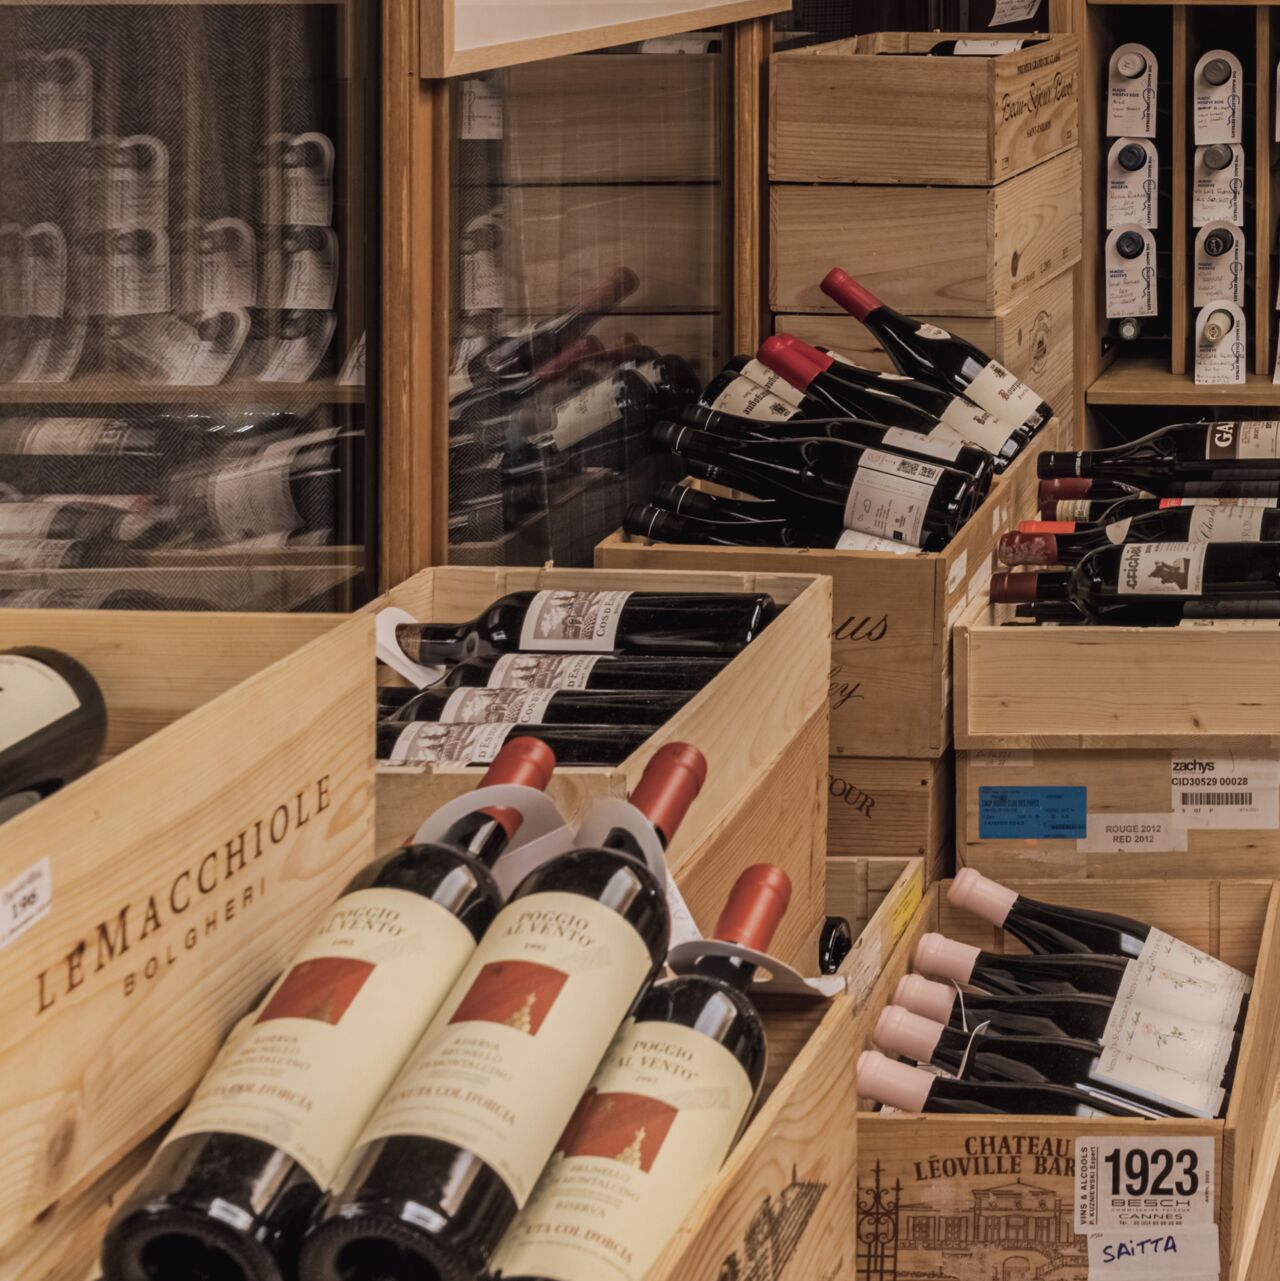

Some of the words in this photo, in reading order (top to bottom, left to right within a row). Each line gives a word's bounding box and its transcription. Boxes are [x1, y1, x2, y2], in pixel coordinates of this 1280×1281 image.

[1172, 759, 1216, 774] zachys
[1219, 776, 1248, 786] 00028
[1106, 825, 1139, 834] ROUGE
[1141, 824, 1162, 833] 2012
[1112, 834, 1132, 844] RED
[1134, 834, 1155, 843] 2012
[518, 910, 590, 931] POGGIO
[124, 876, 266, 998] BOLGHERI
[632, 1039, 694, 1062] POGGIO
[913, 1149, 1022, 1181] LÉOVILLE
[1089, 1146, 1097, 1170] Expert
[1080, 1146, 1088, 1193] ALCOOLS
[1105, 1148, 1199, 1197] 1923
[1112, 1199, 1190, 1207] BESCH
[1080, 1205, 1088, 1225] VINS
